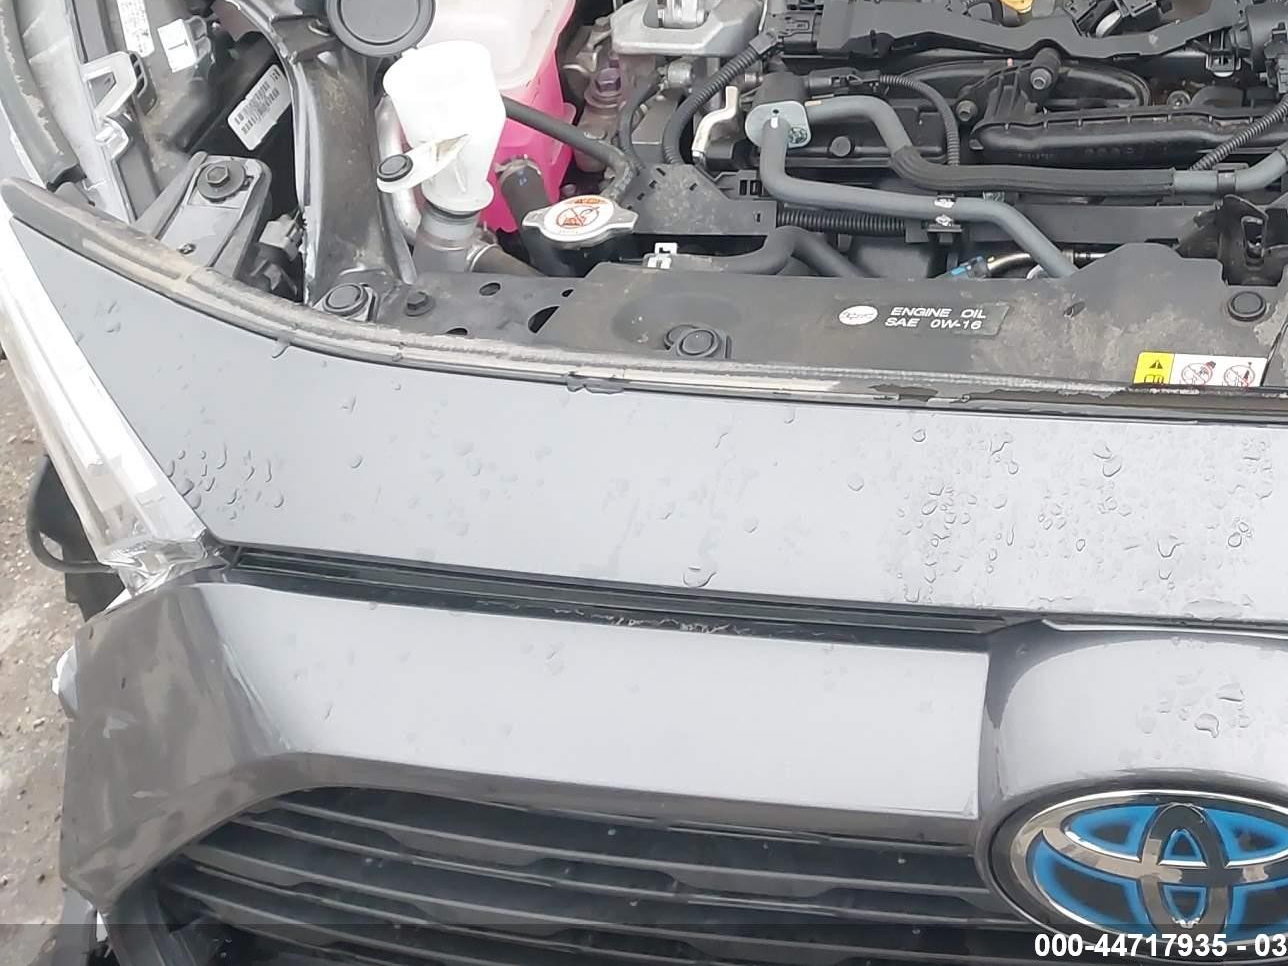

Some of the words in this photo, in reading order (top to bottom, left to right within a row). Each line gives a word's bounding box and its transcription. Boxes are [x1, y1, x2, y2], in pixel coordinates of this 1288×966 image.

[890, 307, 952, 318] ENGINE
[960, 308, 987, 319] OIL
[884, 317, 921, 327] SAE
[930, 319, 983, 330] 0W-16
